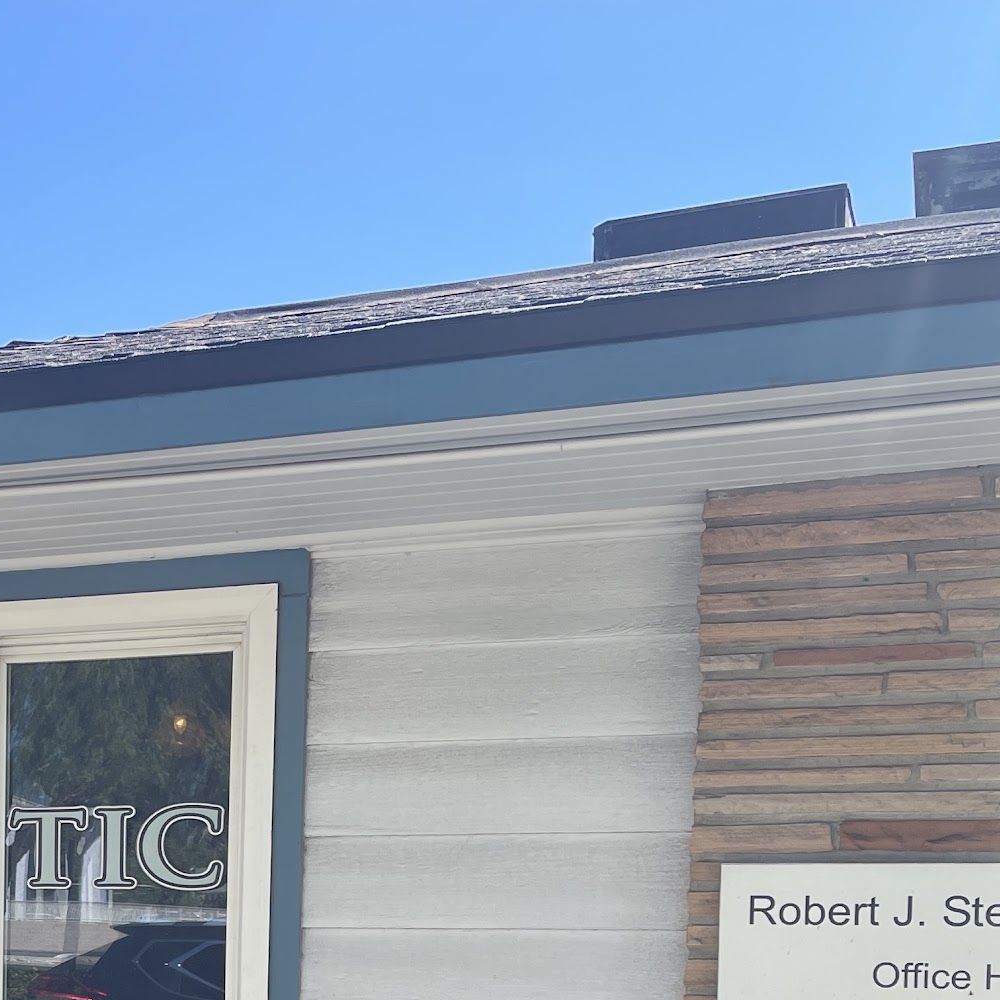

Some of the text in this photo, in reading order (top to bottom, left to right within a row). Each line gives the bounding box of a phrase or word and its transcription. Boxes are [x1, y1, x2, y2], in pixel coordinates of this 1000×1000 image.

[749, 895, 880, 926] Robert
[893, 896, 925, 927] J.
[873, 961, 971, 990] Office
